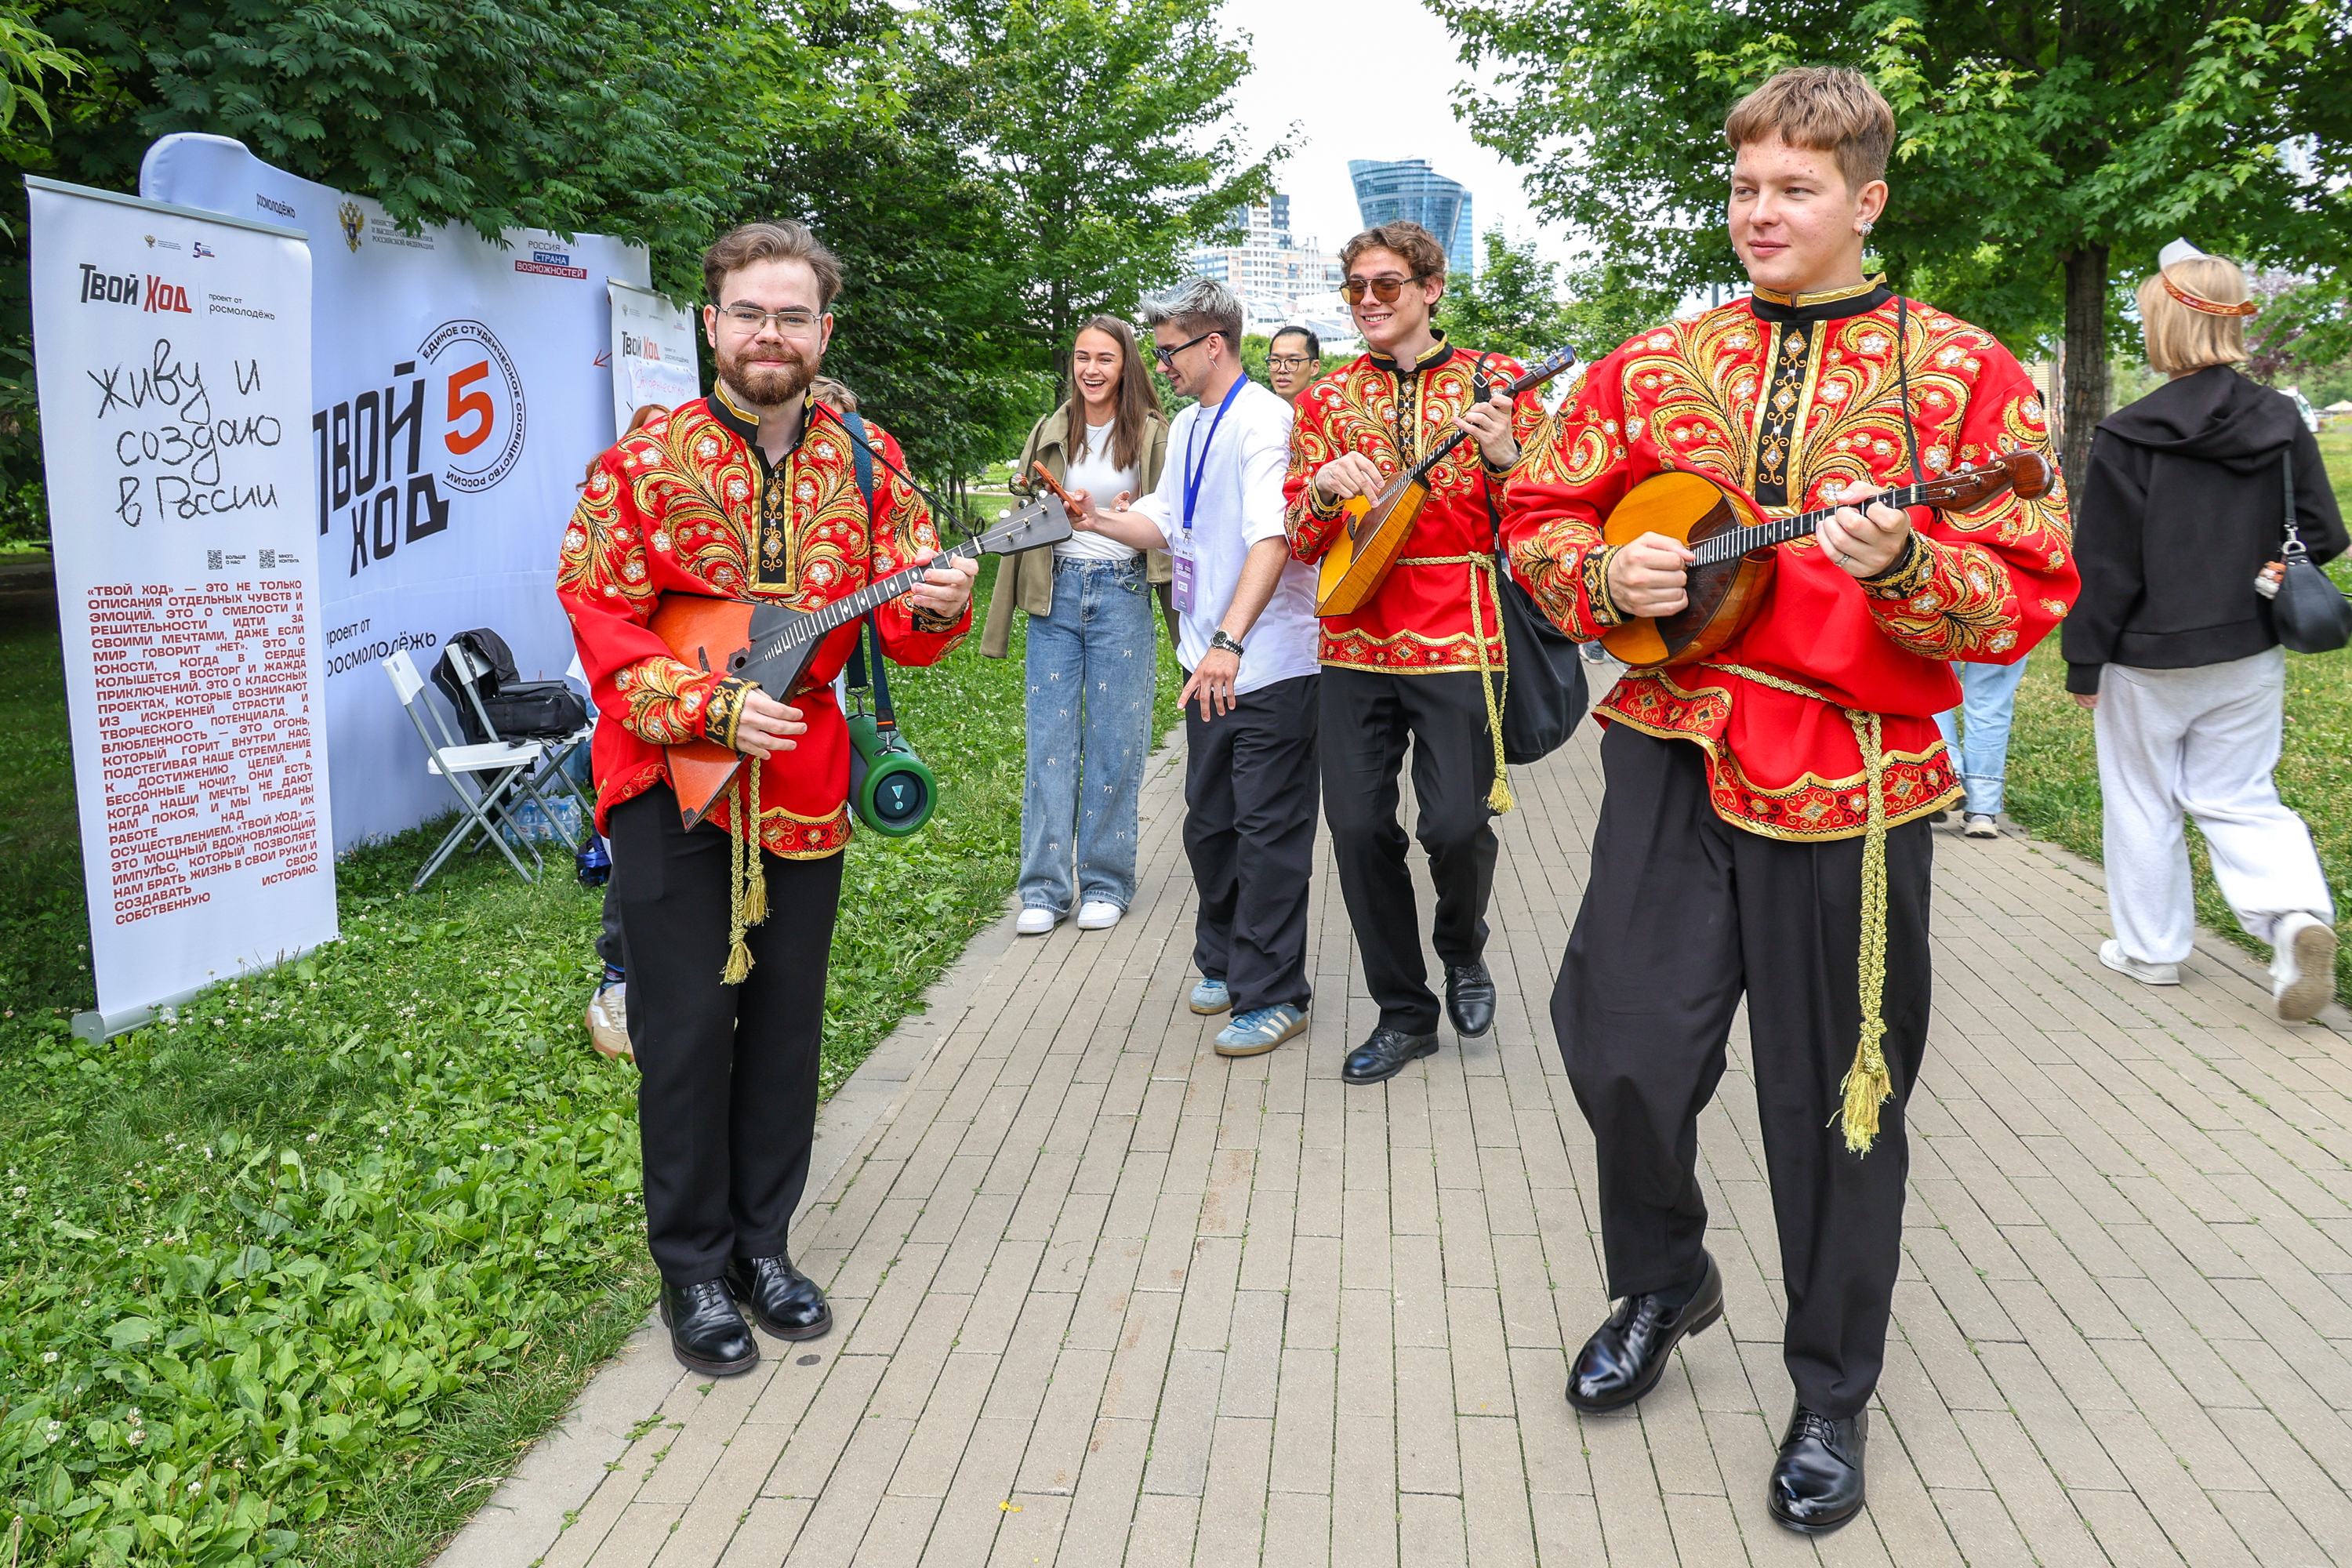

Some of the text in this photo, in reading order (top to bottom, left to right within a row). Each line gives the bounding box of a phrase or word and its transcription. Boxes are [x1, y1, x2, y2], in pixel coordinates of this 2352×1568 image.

[372, 236, 434, 250] РОССИЙСКОЙ ФЕДЕРАЦИИ
[528, 240, 560, 252] РОССИЯ
[535, 253, 567, 265] СТРАНА
[517, 261, 584, 278] ВОЗМОЖНОСТЕЙ
[209, 293, 232, 302] проект
[209, 304, 275, 320] росмолодёжь
[87, 339, 261, 424] живу и
[422, 325, 523, 488] ЕДИНОЕ СТУДЕНЧЕСКОЕ СООБЩЕСТВО РОССИИ
[444, 359, 494, 456] 5
[117, 415, 281, 486] создаю
[115, 475, 279, 527] в России
[350, 473, 450, 578] ХОД
[87, 583, 133, 596] «ТВОЙ
[142, 585, 173, 595] ХОД»
[206, 583, 228, 593] ЭТО
[237, 582, 251, 591] НЕ
[259, 580, 302, 590] ТОЛЬКО
[87, 597, 162, 610] ОПИСАНИЯ
[168, 595, 242, 607] ОТДЕЛЬНЫХ
[248, 592, 292, 602] ЧУВСТВ
[89, 608, 155, 623] ЭМОЦИЙ.
[166, 608, 193, 619] ЭТО
[204, 607, 213, 617] О
[223, 604, 288, 616] СМЕЛОСТИ
[90, 614, 303, 635] РЕШИТЕЛЬНОСТИ ИДТИ ЗА
[361, 619, 370, 633] от
[92, 626, 304, 649] СВОИМИ МЕЧТАМИ, ДАЖЕ ЕСЛИ
[93, 637, 305, 662] МИР ГОВОРИТ «НЕТ». ЭТО О
[94, 648, 306, 675] ЮНОСТИ, КОГДА В СЕРДЦЕ
[95, 659, 306, 688] КОЛЫШЕТСЯ ВОСТОРГ И ЖАЖДА
[97, 671, 307, 701] ПРИКЛЮЧЕНИЙ. ЭТО О КЛАССНЫХ
[98, 682, 307, 714] ПРОЕКТАХ, КОТОРЫЕ ВОЗНИКАЮТ
[99, 693, 308, 728] ИЗ ИСКРЕННЕЙ СТРАСТИ И
[100, 720, 193, 740] ТВОРЧЕСКОГО
[211, 708, 288, 725] ПОТЕНЦИАЛА.
[101, 731, 207, 754] ВЛЮБЛЕННОСТЬ
[239, 723, 262, 734] ЭТО
[273, 717, 310, 729] ОГОНЬ,
[102, 727, 310, 767] КОТОРЫЙ ГОРИТ ВНУТРИ НАС,
[103, 739, 311, 780] ПОДСТЕГИВАЯ НАШЕ СТРЕМЛЕНИЕ
[105, 750, 312, 793] К ДОСТИЖЕНИЮ ЦЕЛЕЙ. А
[106, 762, 312, 807] БЕССОННЫЕ НОЧИ? ОНИ ЕСТЬ,
[107, 772, 313, 820] КОГДА НАШИ МЕЧТЫ НЕ ДАЮТ
[108, 785, 314, 833] НАМ ПОКОЯ, И МЫ ПРЕДАНЫ
[109, 797, 314, 846] РАБОТЕ НАД ИХ
[110, 825, 234, 859] ОСУЩЕСТВЛЕНИЕМ.
[237, 815, 271, 830] «ТВОЙ
[275, 810, 302, 822] ХОД»
[111, 818, 315, 872] ЭТО МОЩНЫЙ ВДОХНОВЛЯЮЩИЙ
[112, 829, 316, 886] ИМПУЛЬС, КОТОРЫЙ ПОЗВОЛЯЕТ
[113, 841, 317, 898] НАМ БРАТЬ ЖИЗНЬ В СВОИ РУКИ И
[114, 852, 318, 912] СОЗДАВАТЬ СВОЮ
[116, 864, 318, 925] СОБСТВЕННУЮ ИСТОРИЮ.
